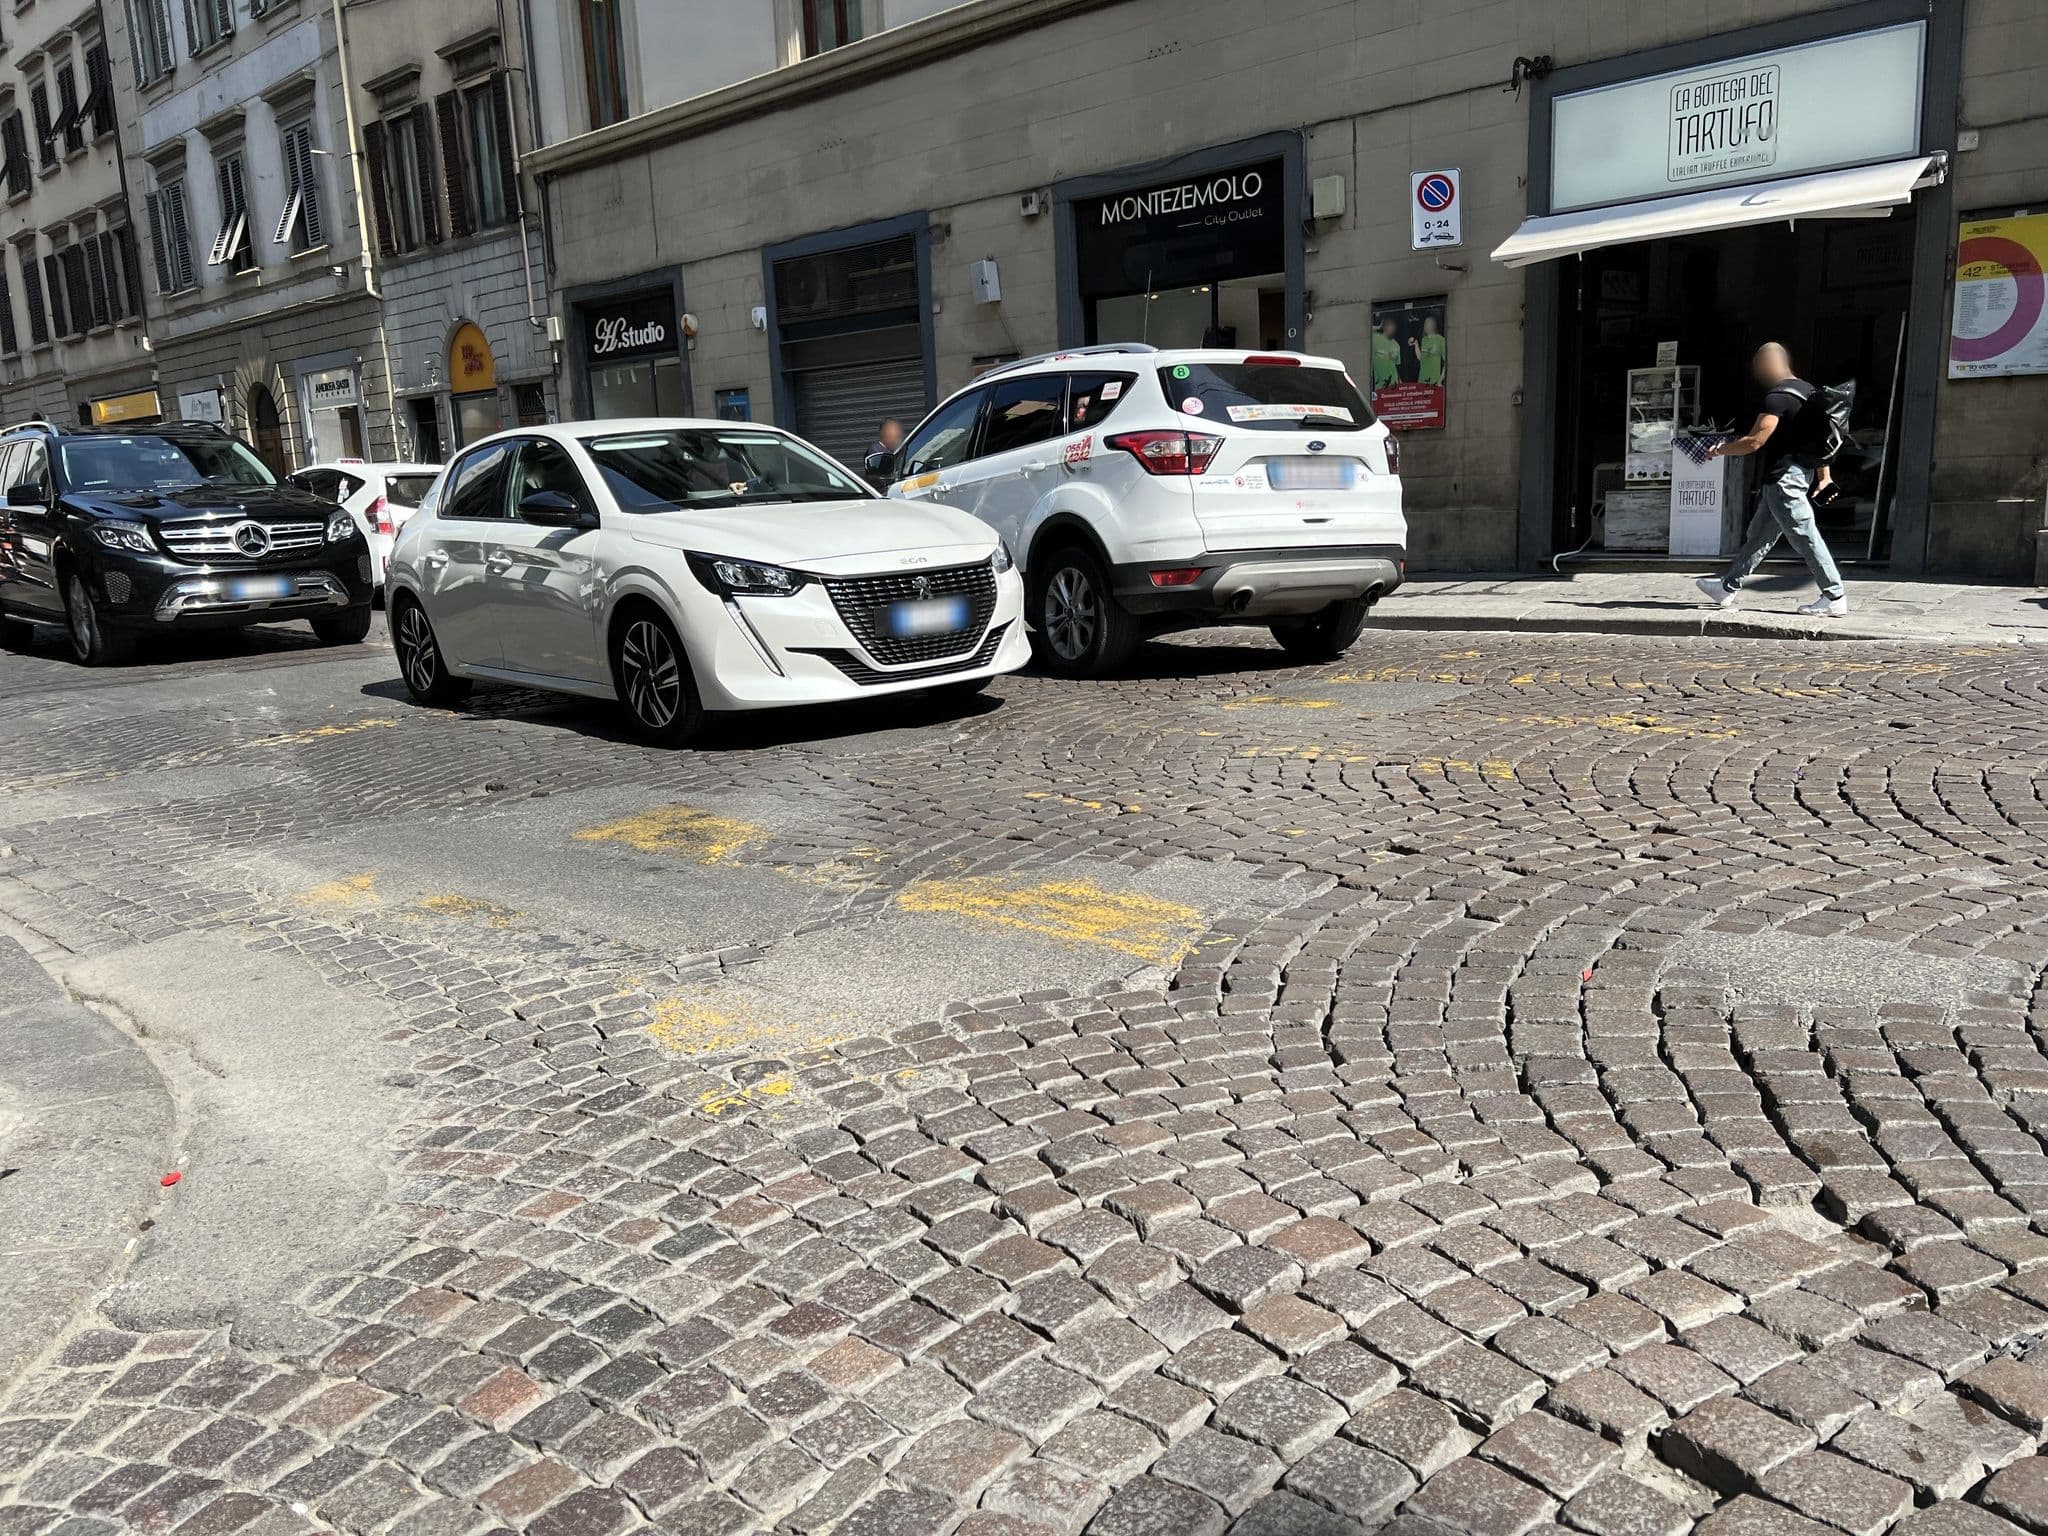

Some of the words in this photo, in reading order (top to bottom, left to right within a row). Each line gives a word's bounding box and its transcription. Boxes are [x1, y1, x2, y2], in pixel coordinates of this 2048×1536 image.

[1675, 88, 1690, 112] LA
[1694, 77, 1746, 108] BOTTEGA
[1751, 71, 1773, 97] DEL
[1675, 99, 1773, 156] TARTUFO
[1672, 164, 1698, 178] ITALIAN
[1700, 159, 1727, 173] TRUFFLE
[1101, 172, 1263, 225] MONTEZEMOLO
[1204, 215, 1226, 226] City
[1228, 208, 1264, 222] Outlet
[1177, 368, 1185, 377] 8
[1678, 490, 1716, 506] TARTUFO
